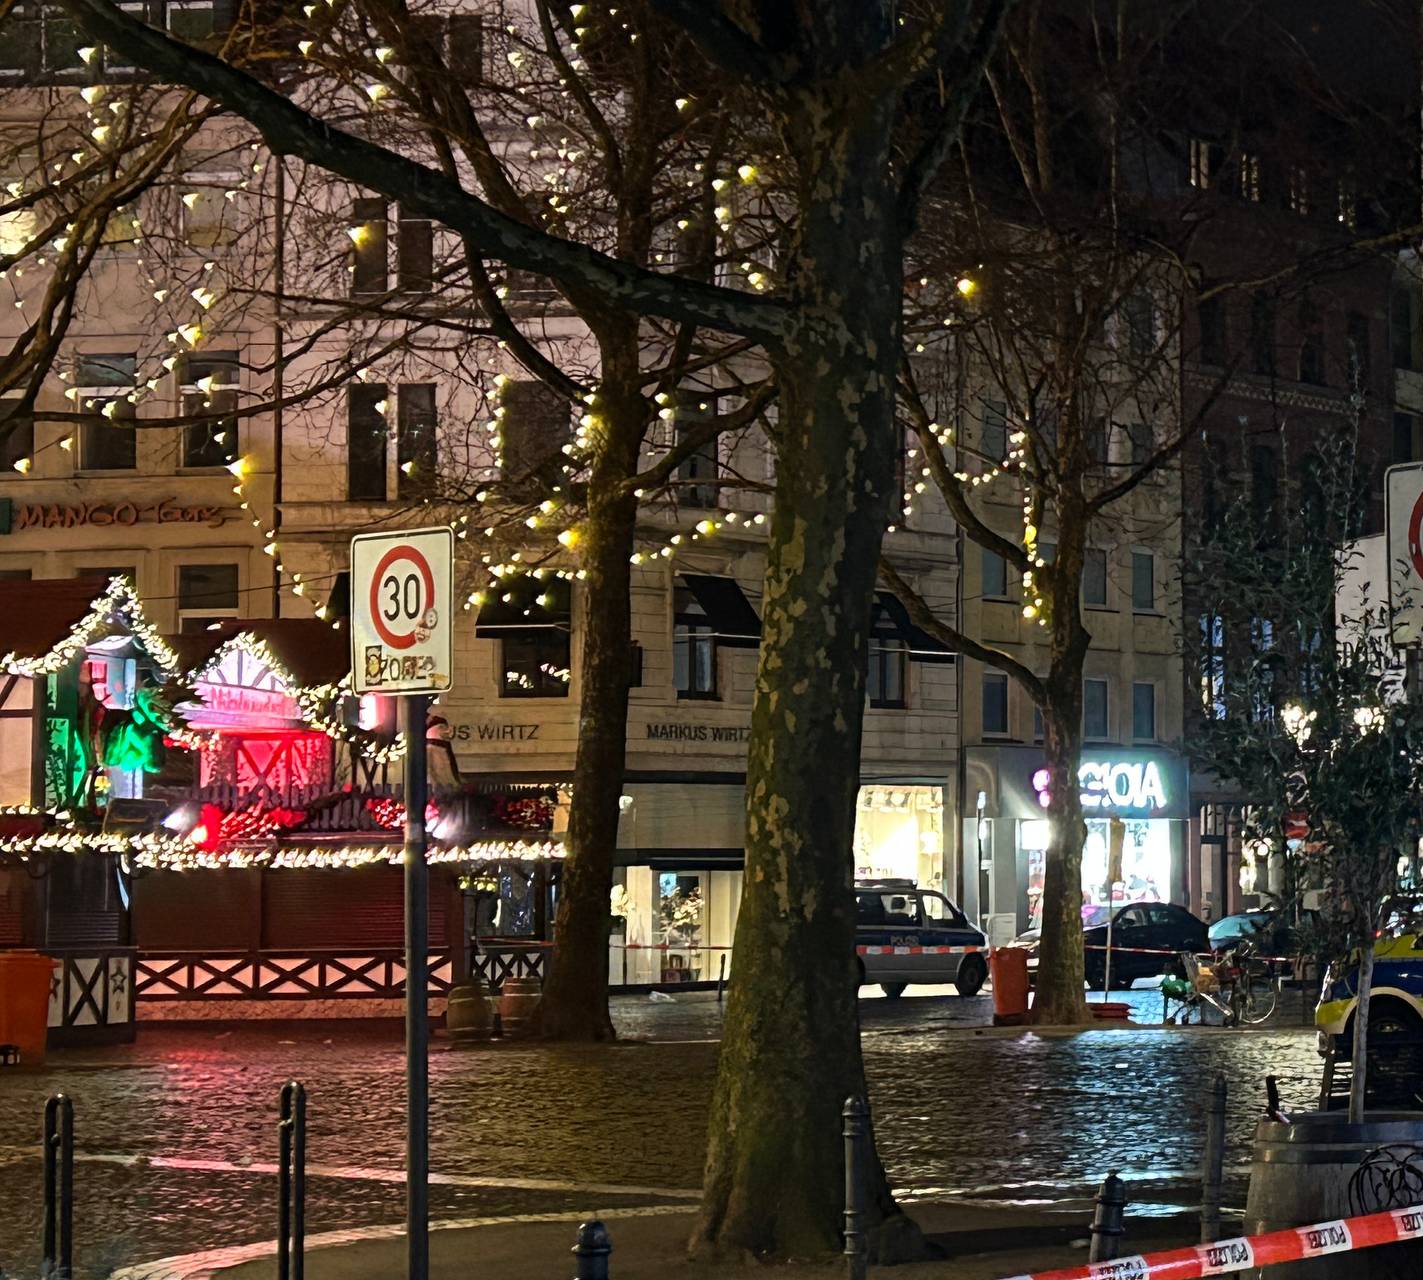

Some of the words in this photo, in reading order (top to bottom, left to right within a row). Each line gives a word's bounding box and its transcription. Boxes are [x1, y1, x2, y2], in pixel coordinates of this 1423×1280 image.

[17, 502, 139, 530] MANGO
[383, 573, 421, 622] 30
[478, 724, 539, 740] WIRTZ
[646, 724, 707, 741] MARKUS
